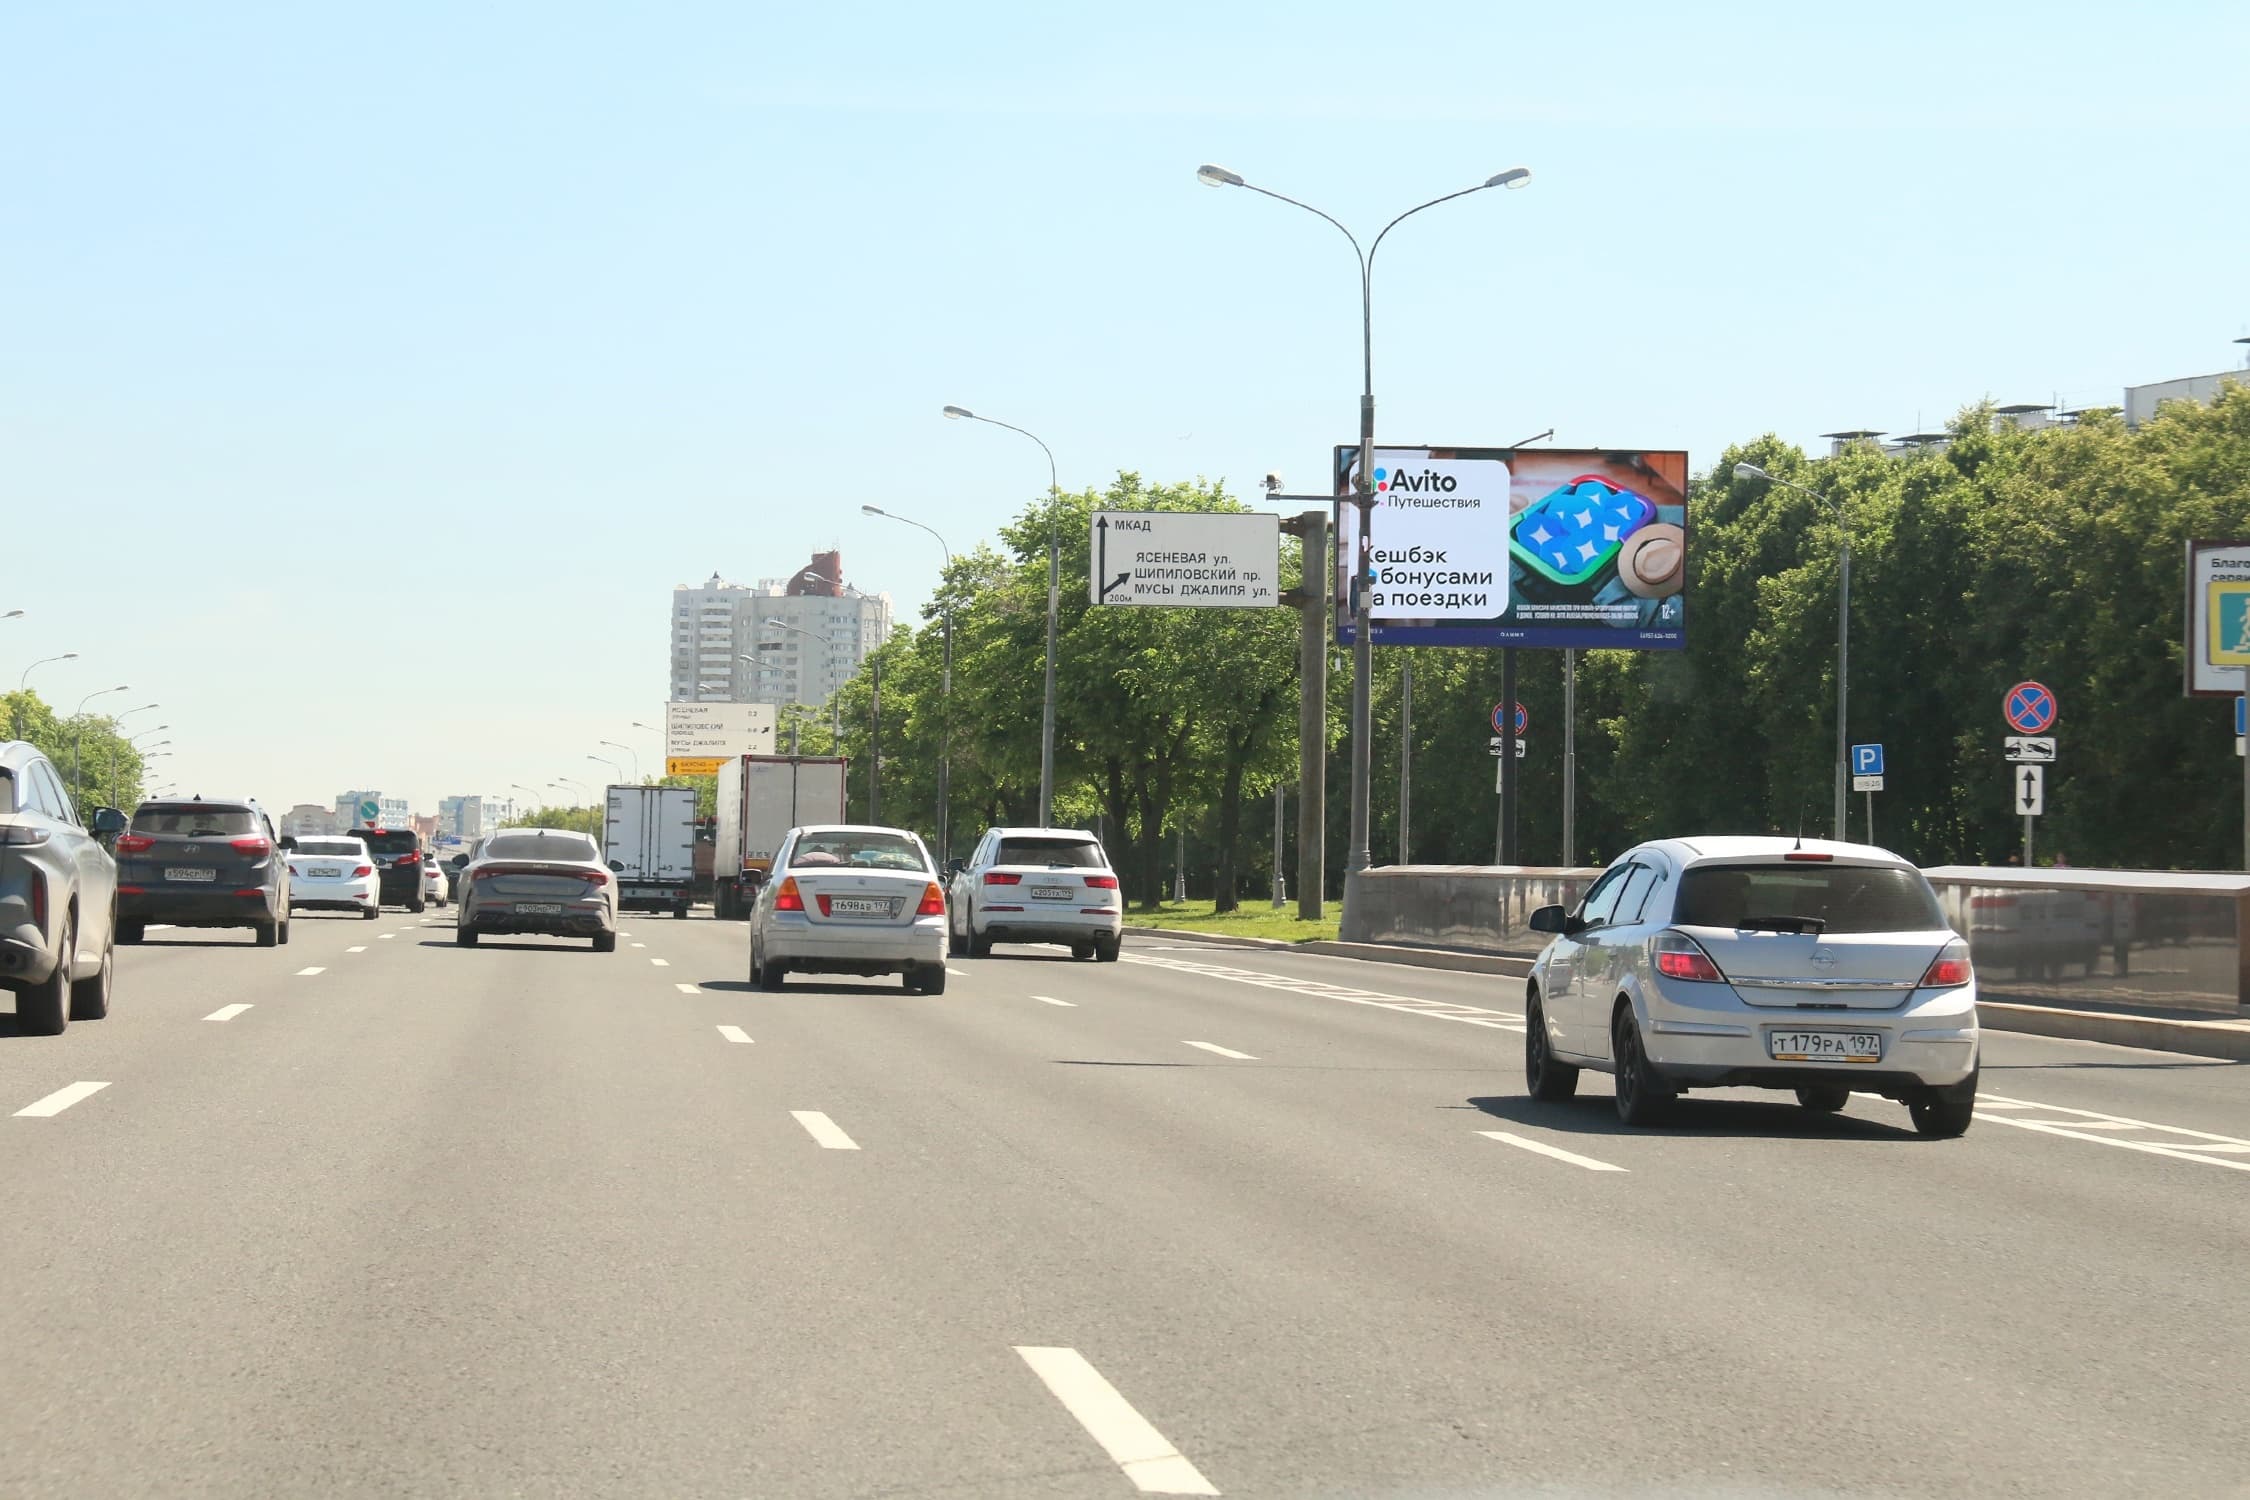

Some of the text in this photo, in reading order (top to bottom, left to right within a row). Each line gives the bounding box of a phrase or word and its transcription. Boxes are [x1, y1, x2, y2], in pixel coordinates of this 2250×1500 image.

[1389, 469, 1458, 493] Avito
[1387, 495, 1481, 509] Путешествия
[1115, 520, 1151, 532] МКАД
[1136, 552, 1231, 565] ЯСЕНЕВАЯ ул.
[1135, 567, 1261, 582] ШИПИЛОВСКИЙ пр.
[1381, 567, 1493, 589] бонусами
[1135, 583, 1271, 598] МУСЫ ДЖАЛИЛЯ ул.
[1109, 594, 1132, 603] 200м
[1391, 593, 1487, 608] поездки
[1661, 604, 1676, 620] 12+
[1778, 1035, 1845, 1053] Т179РА
[1849, 1036, 1874, 1049] 197
